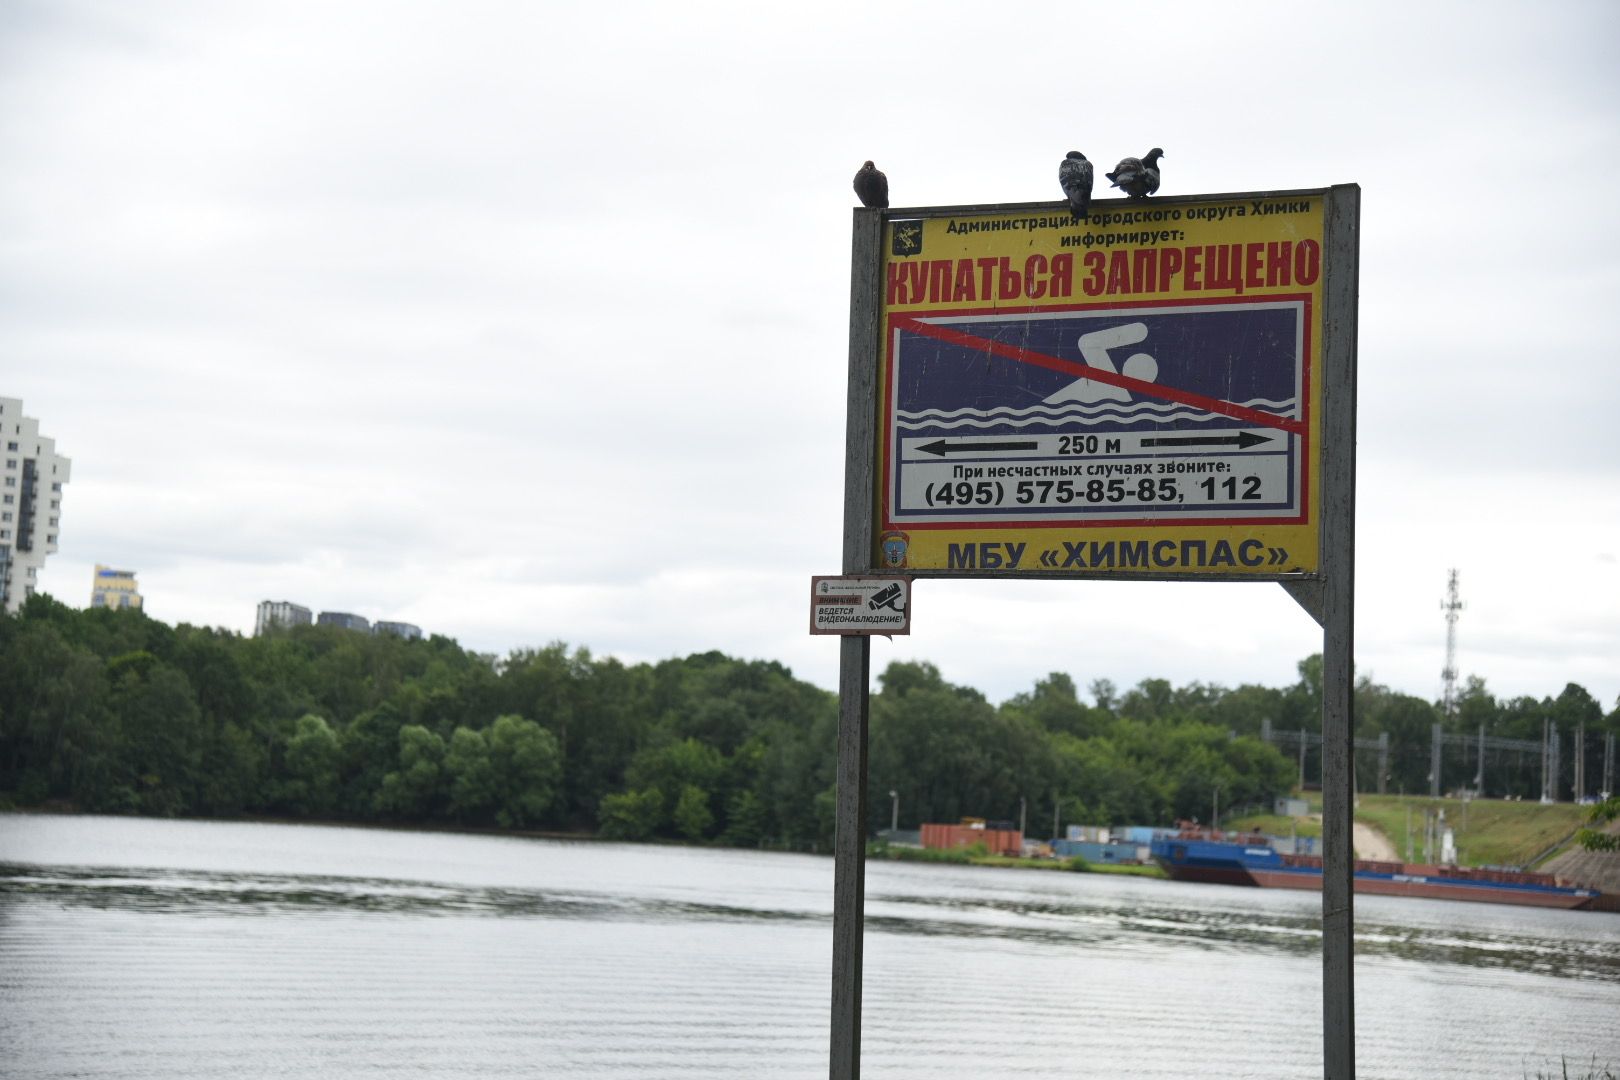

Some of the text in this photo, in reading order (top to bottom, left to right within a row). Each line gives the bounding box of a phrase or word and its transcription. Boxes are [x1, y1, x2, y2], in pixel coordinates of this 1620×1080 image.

[946, 200, 1310, 235] Администрация городского округа Химки
[1060, 229, 1184, 249] информирует:
[887, 239, 1320, 305] КУПАТЬСЯ ЗАПРЕЩЕНО
[1058, 435, 1121, 455] 250 м
[953, 460, 1231, 479] При несчастных случаях звоните:
[925, 476, 1262, 507] (495) 575-85-85, 112
[947, 538, 1289, 569] МБУ «ХИМСПАС»
[818, 607, 854, 615] ВЕДЕТСЯ
[818, 615, 902, 624] ВИДЕОНАБЛЮДЕНИЕ!
